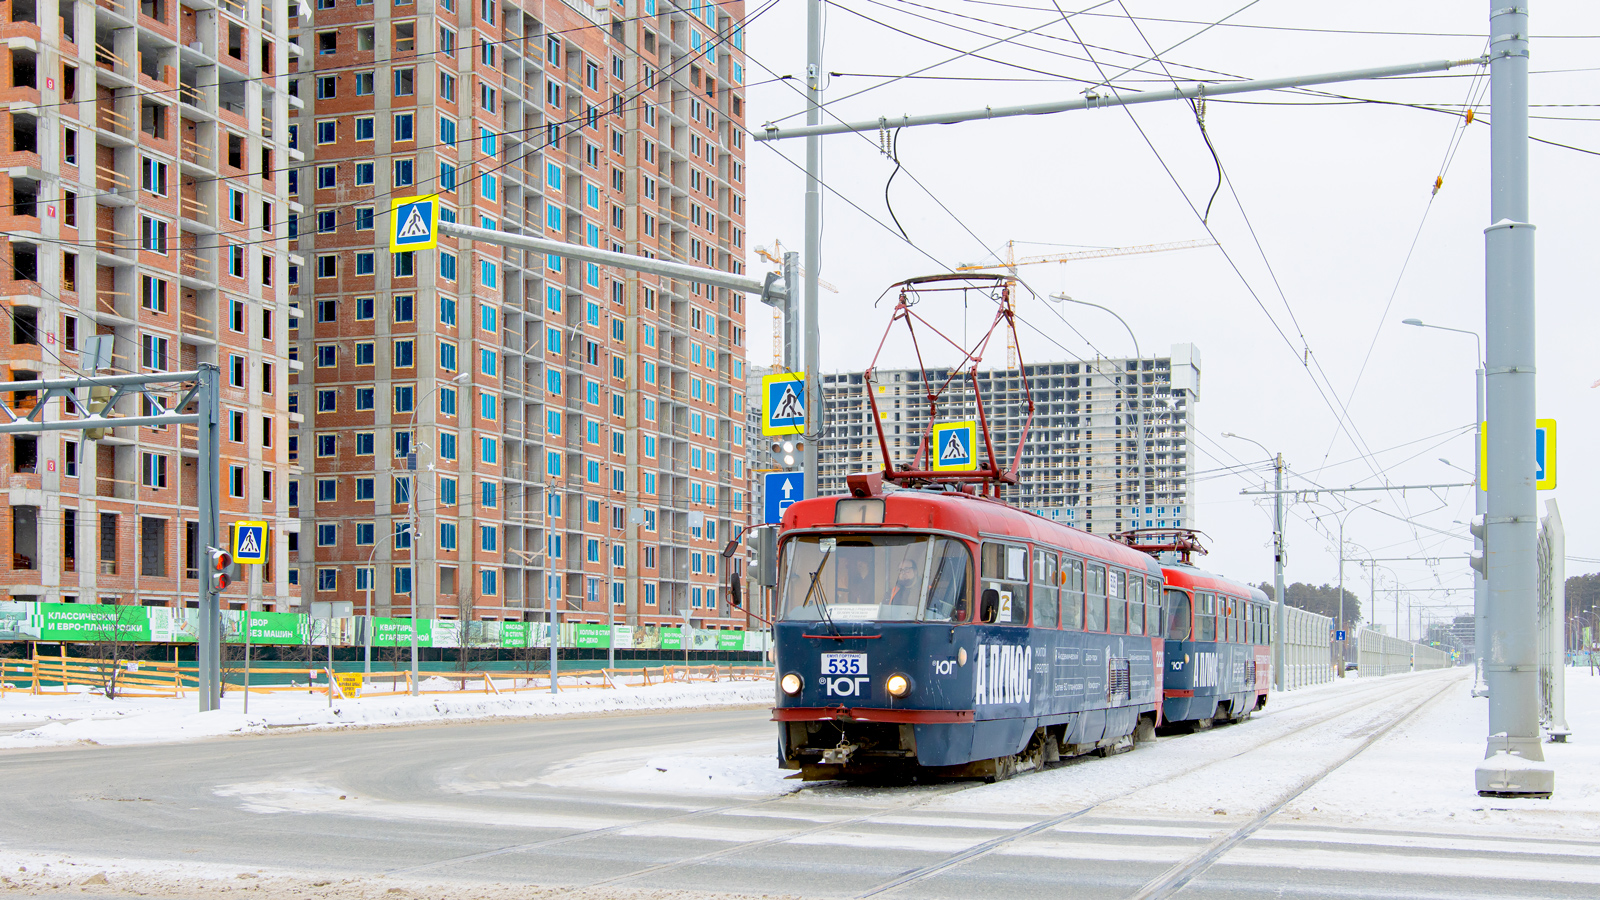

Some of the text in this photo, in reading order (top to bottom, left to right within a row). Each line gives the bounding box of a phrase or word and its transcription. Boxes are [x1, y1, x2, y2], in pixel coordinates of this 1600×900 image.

[858, 505, 867, 523] 1
[1001, 594, 1011, 612] 2
[48, 623, 55, 631] И
[263, 630, 293, 638] МАШИН
[385, 633, 430, 642] ГАРДЕРОНОЙ
[828, 658, 860, 674] 535
[976, 644, 1032, 705] А ПЛЮС
